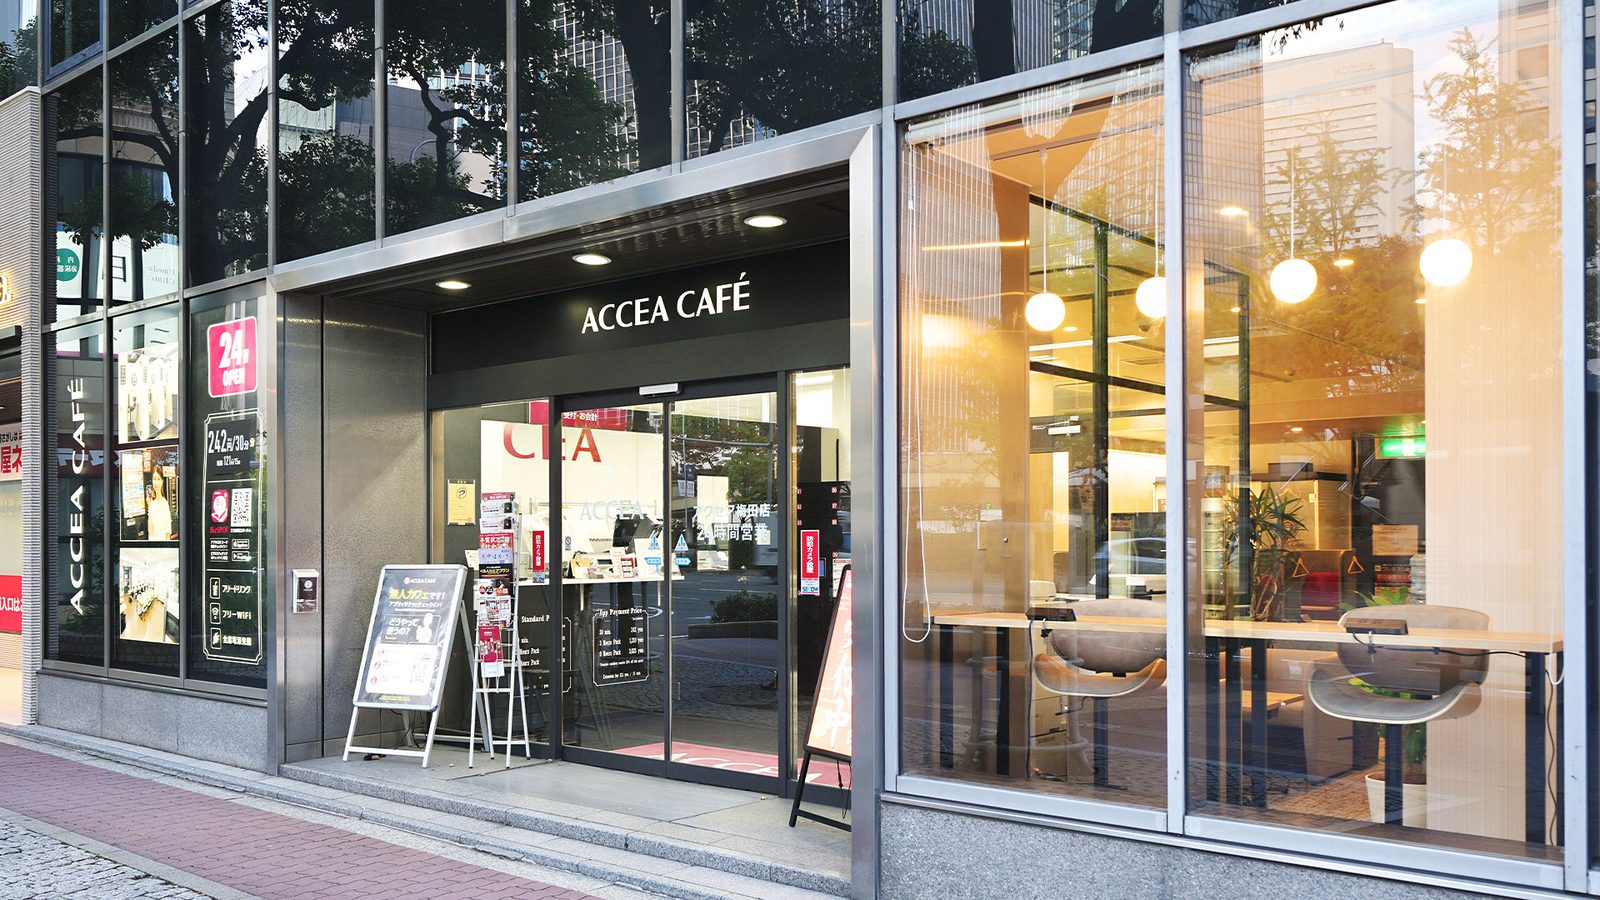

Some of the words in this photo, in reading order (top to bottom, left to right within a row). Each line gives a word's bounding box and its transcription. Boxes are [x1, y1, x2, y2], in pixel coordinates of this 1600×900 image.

[581, 295, 670, 334] ACCEA
[676, 271, 750, 319] CAFÉ
[222, 367, 246, 387] OPEN
[67, 377, 85, 475] CAFÉ
[580, 500, 645, 521] ACCEA
[696, 522, 769, 545] 24時間営業
[70, 485, 84, 616] ACCEA
[221, 584, 252, 594] フリードリンク
[521, 615, 545, 623] Standard
[609, 608, 630, 616] Payment
